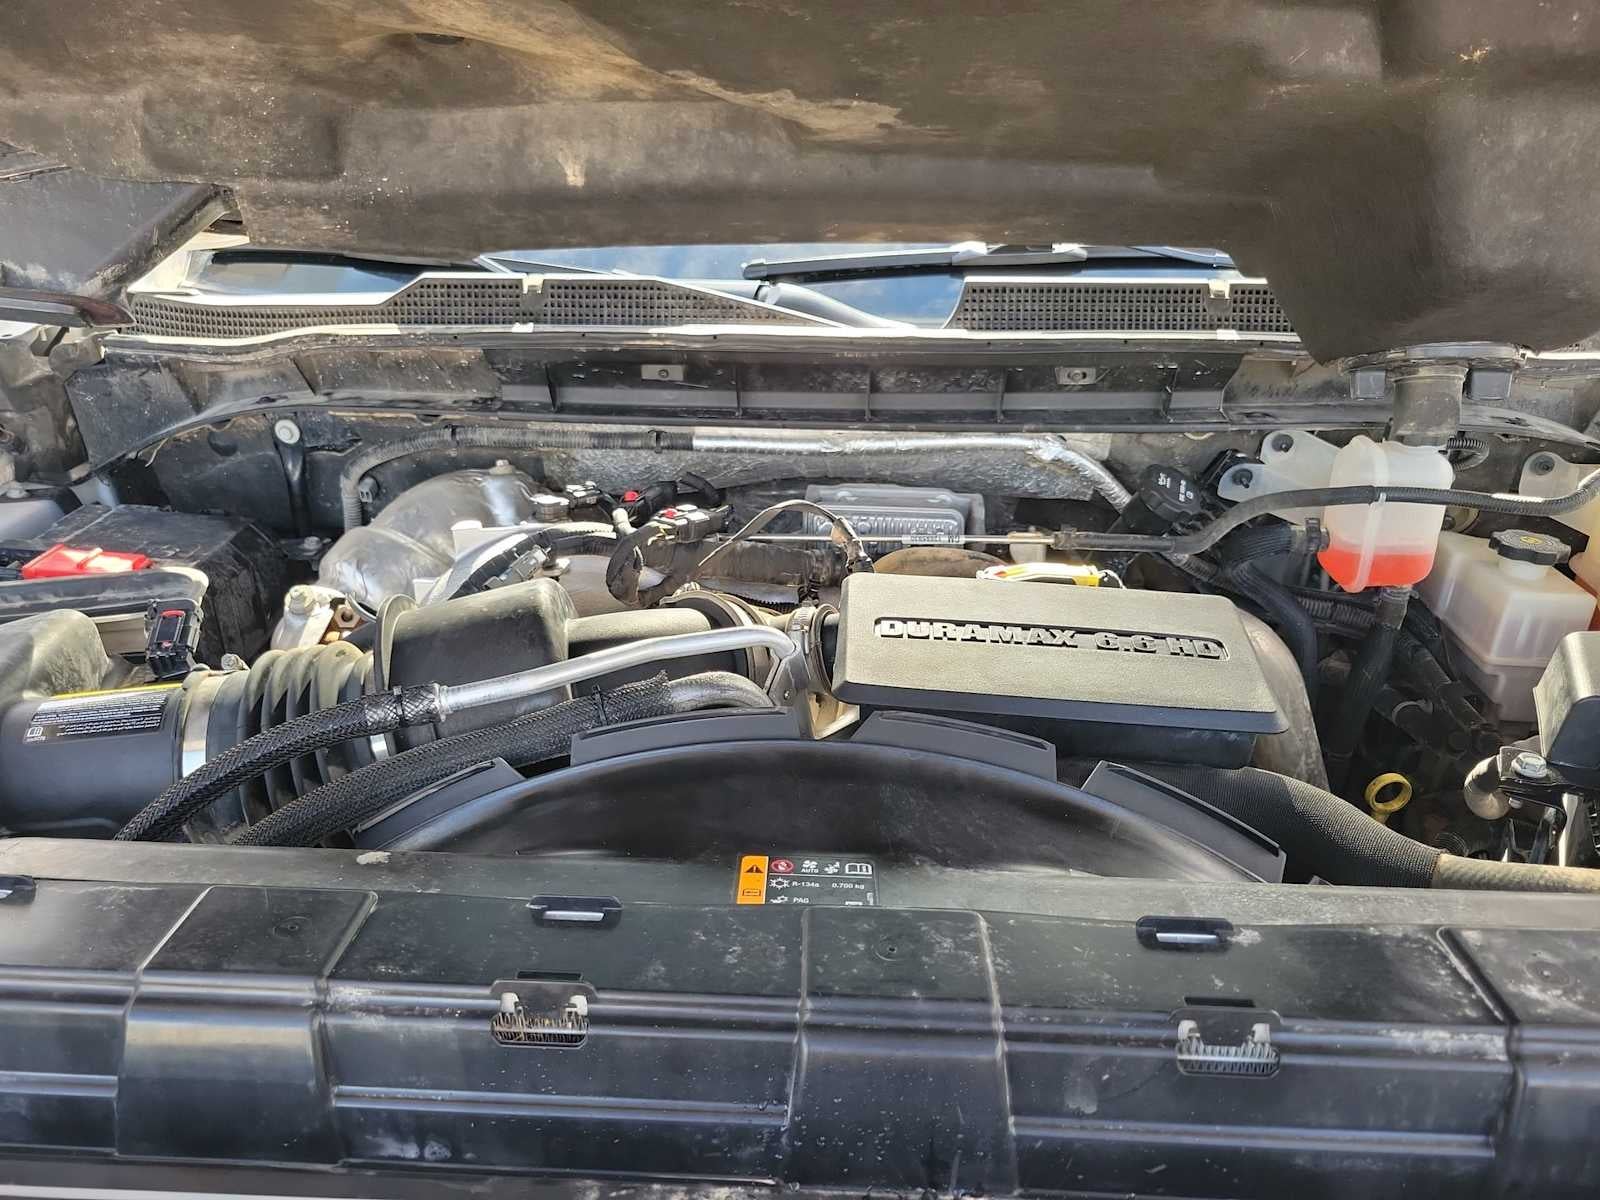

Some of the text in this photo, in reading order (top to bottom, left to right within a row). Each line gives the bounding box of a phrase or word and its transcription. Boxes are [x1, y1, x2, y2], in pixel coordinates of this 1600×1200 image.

[879, 619, 1222, 659] DURAMAX 6.6 HD
